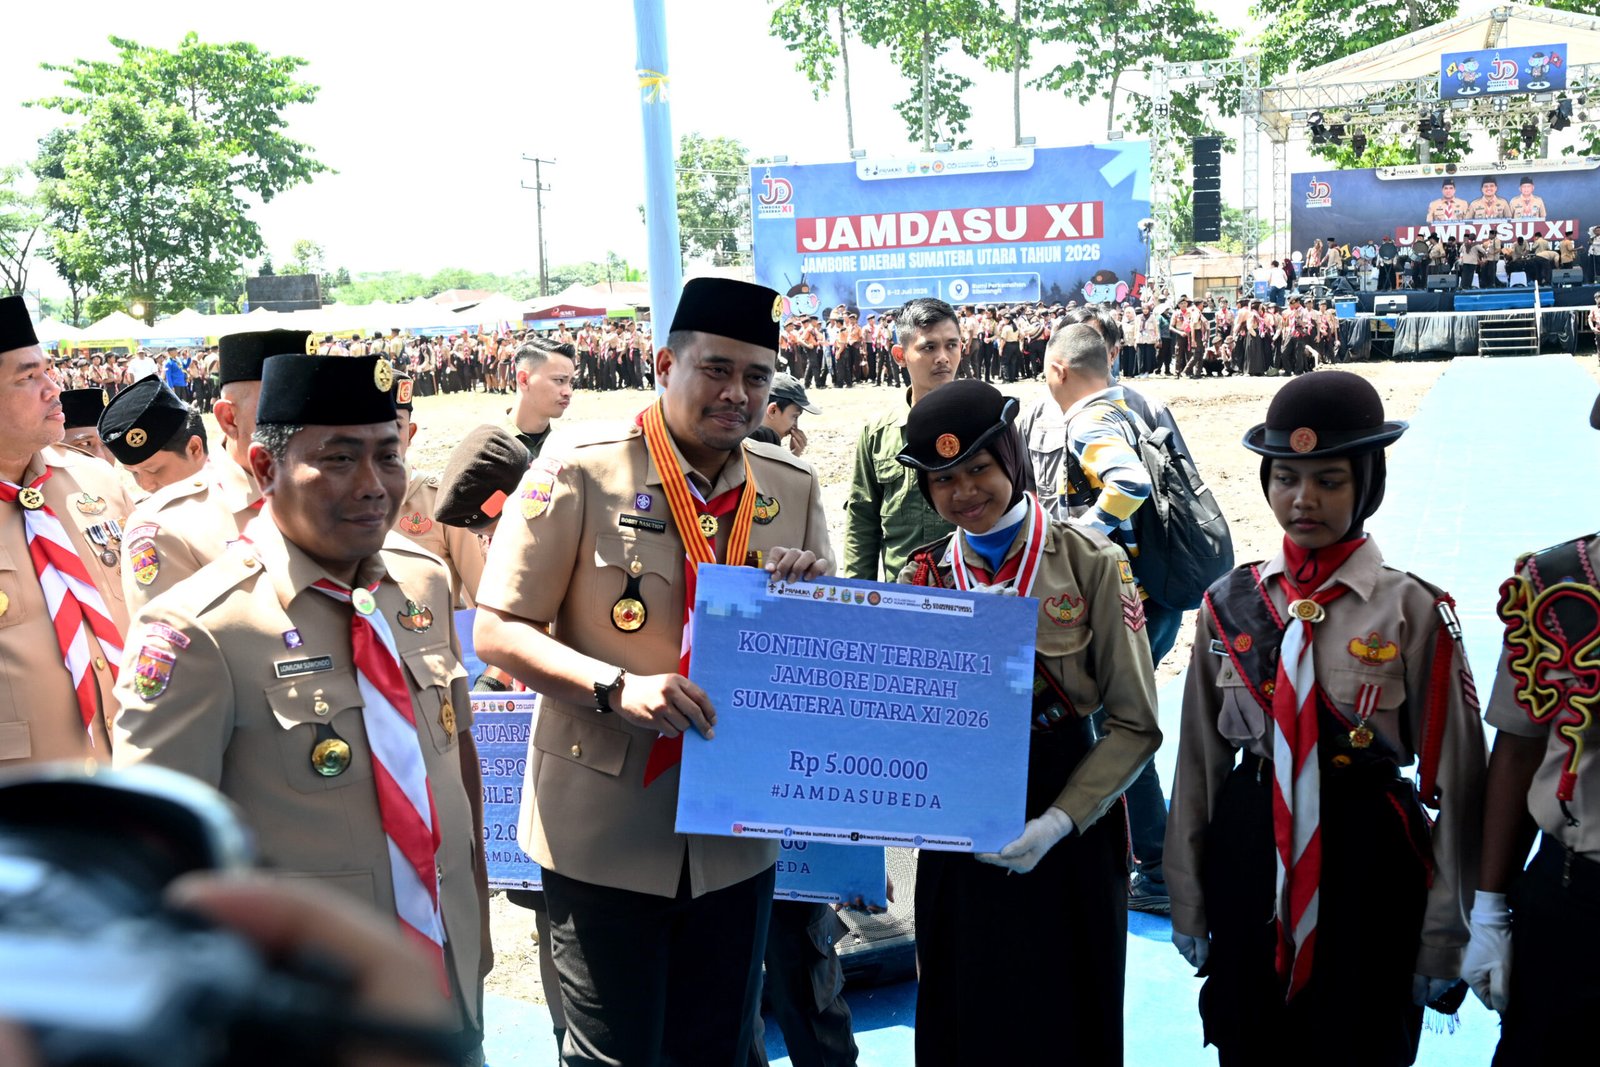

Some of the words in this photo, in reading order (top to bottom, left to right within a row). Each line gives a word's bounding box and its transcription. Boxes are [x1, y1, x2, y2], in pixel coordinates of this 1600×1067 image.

[802, 206, 1027, 251] JAMDASU
[1045, 203, 1095, 238] XI
[1544, 220, 1574, 239] XI
[801, 253, 857, 274] JAMBORE
[861, 252, 905, 271] DAERAH
[909, 249, 973, 268] SUMATERA
[977, 247, 1017, 266] UTARA
[1021, 245, 1061, 263] TAHUN
[1065, 244, 1101, 262] 2026
[738, 631, 876, 664] KONTINGEN
[882, 644, 977, 673] TERBAIK
[981, 655, 991, 675] 1
[771, 665, 869, 690] JAMBORE
[873, 678, 957, 698] DAERAH
[733, 690, 845, 716] SUMATERA
[849, 700, 917, 723] UTARA
[921, 706, 942, 725] XI
[946, 709, 989, 728] 2026
[477, 724, 530, 743] JUARA
[480, 758, 527, 777] E-SPO
[789, 751, 819, 777] Rp
[826, 754, 928, 780] 5.000.000
[771, 784, 942, 809] #JAMDASUBEDA
